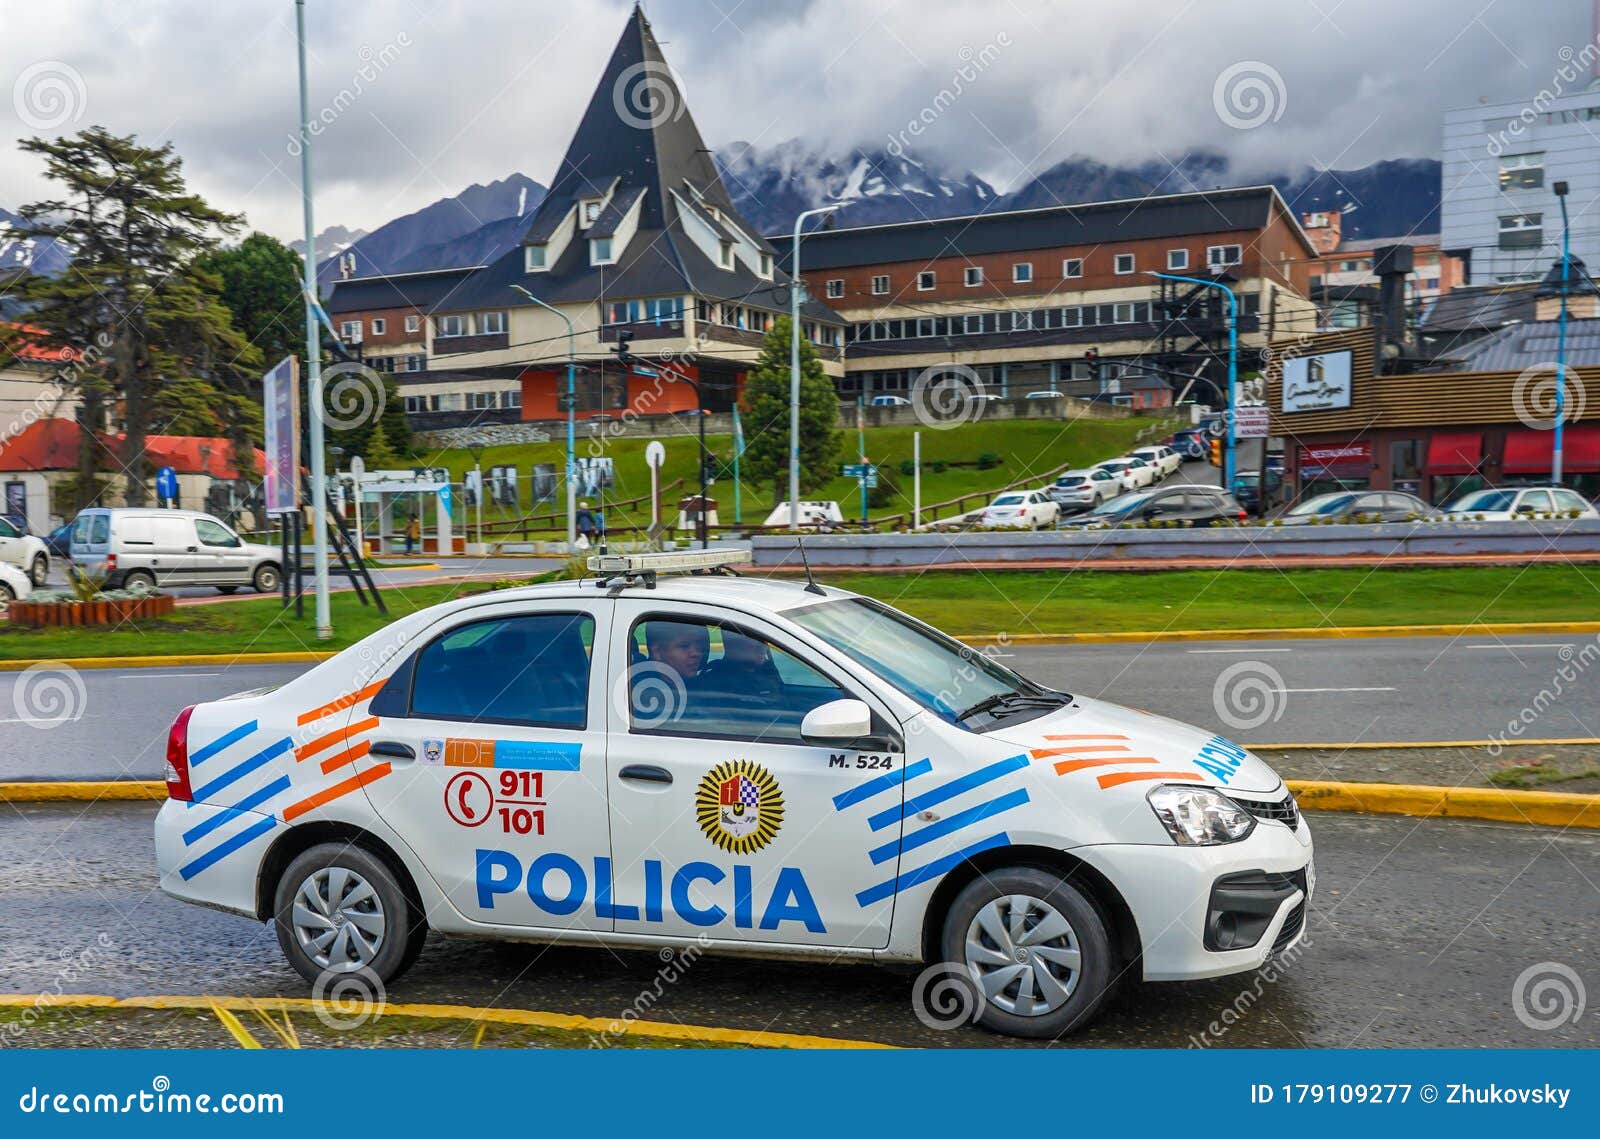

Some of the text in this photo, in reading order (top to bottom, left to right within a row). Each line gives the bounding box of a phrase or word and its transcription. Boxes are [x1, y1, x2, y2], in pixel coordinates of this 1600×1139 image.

[447, 739, 495, 764] TDF
[829, 754, 892, 770] M. 524
[500, 770, 543, 798] 911
[498, 807, 545, 836] 101
[475, 848, 828, 935] POLICIA
